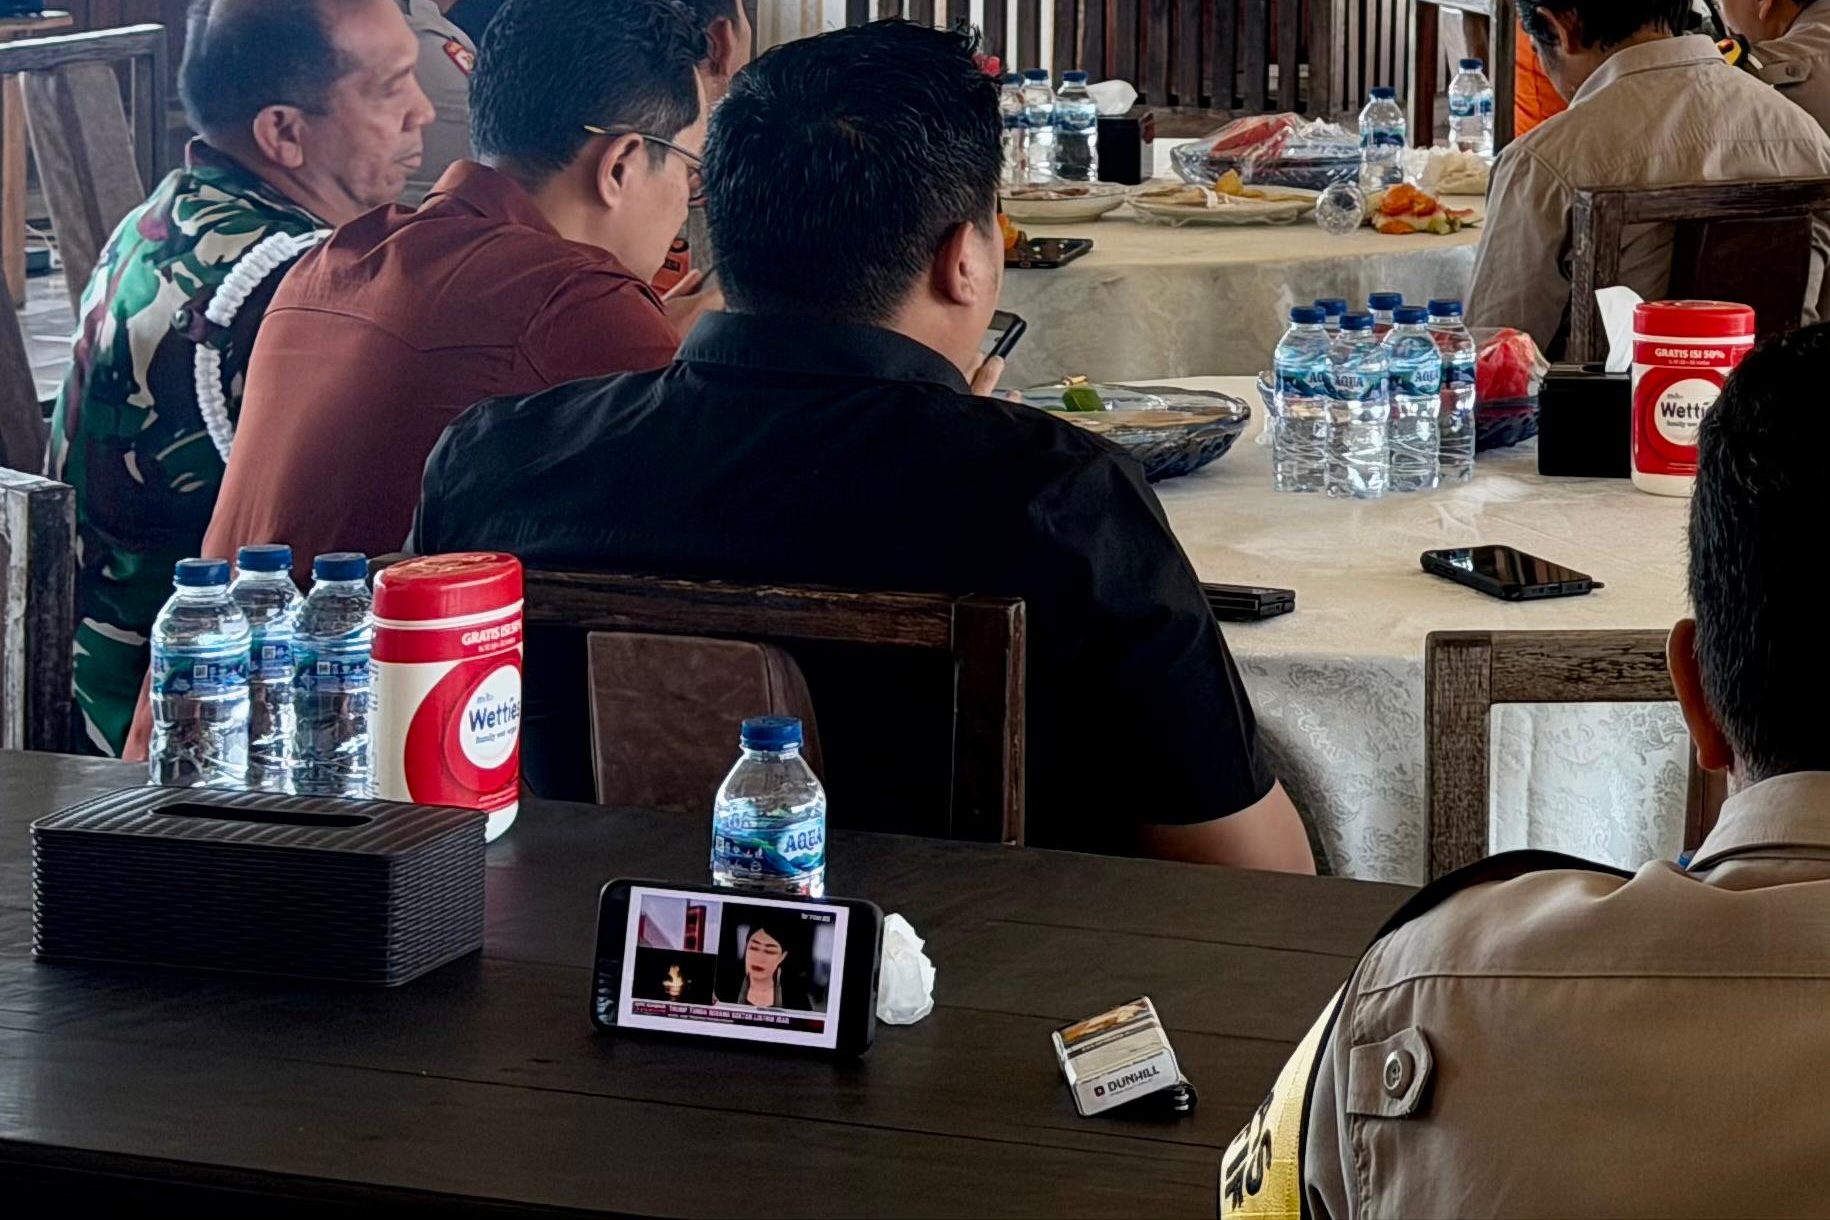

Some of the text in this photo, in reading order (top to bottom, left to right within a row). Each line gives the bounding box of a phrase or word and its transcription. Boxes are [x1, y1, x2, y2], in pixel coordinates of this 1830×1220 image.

[1655, 348, 1688, 358] GRATIS
[1703, 350, 1726, 360] 50%
[1660, 401, 1710, 420] Wetti
[1107, 1064, 1161, 1093] DUNHILL
